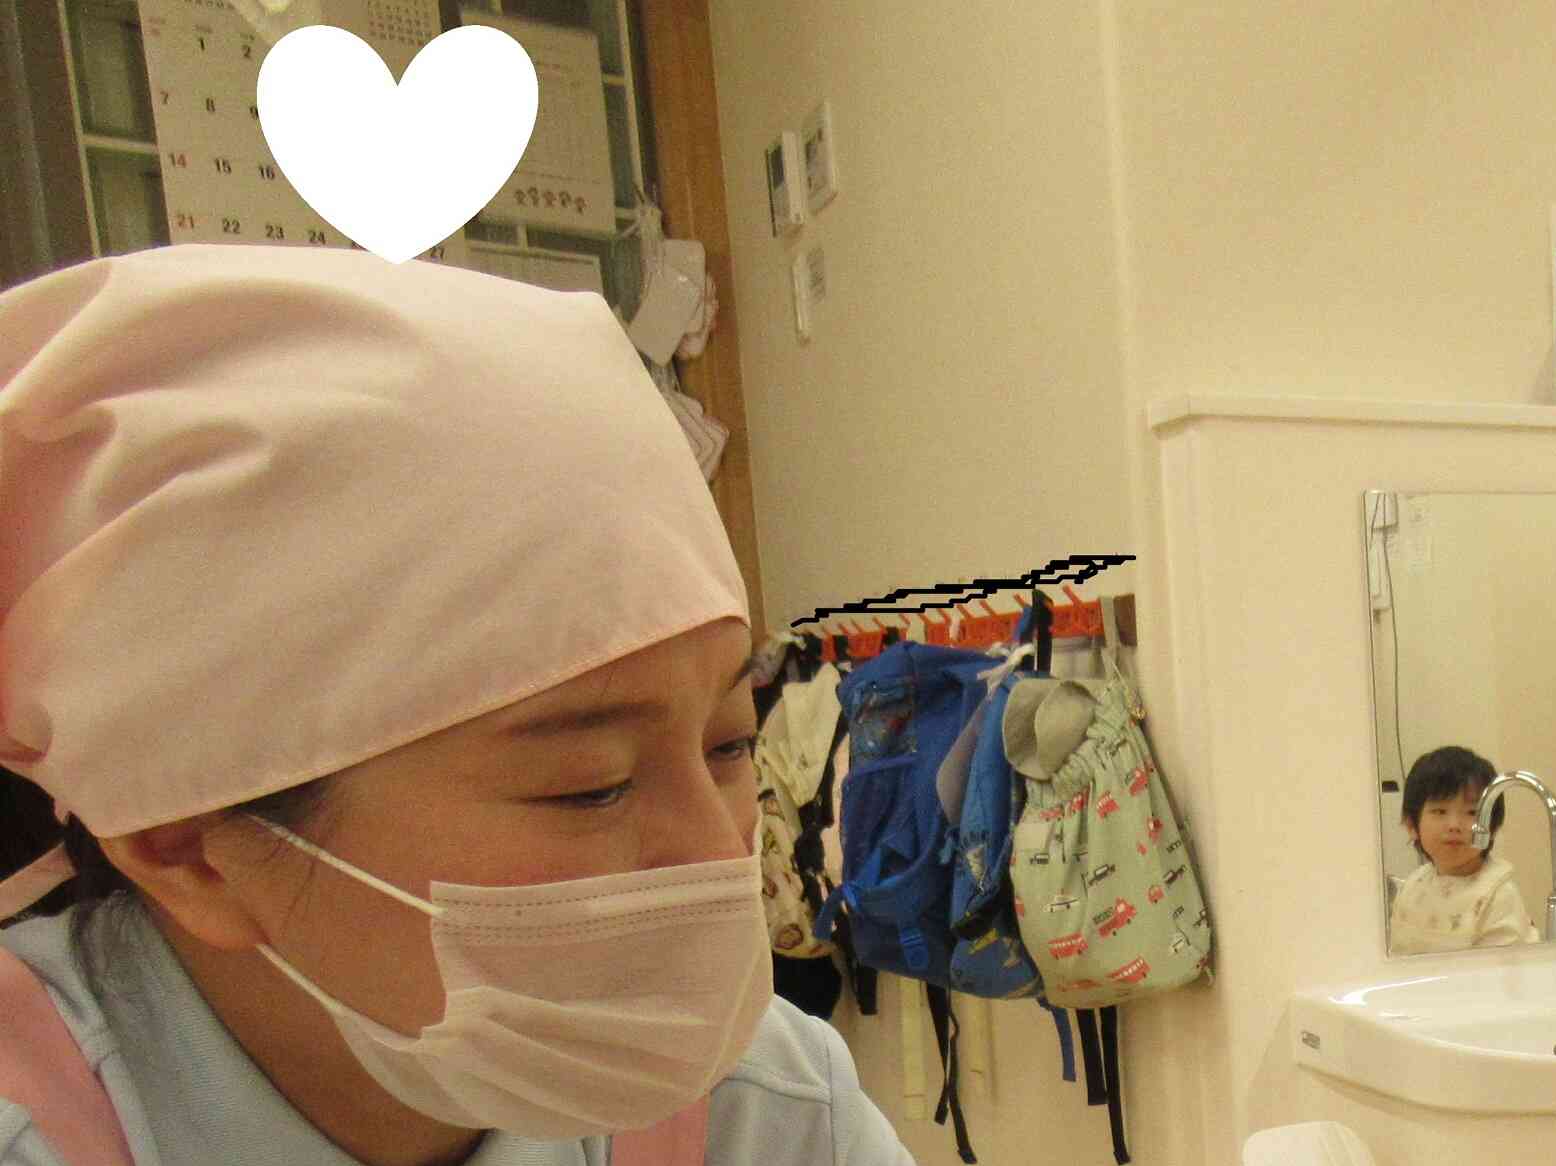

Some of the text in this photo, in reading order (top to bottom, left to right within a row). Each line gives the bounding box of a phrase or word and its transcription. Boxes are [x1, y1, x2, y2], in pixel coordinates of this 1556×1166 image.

[168, 152, 276, 181] 14 15 16
[175, 213, 195, 230] 21
[221, 217, 241, 235] 22
[265, 223, 285, 240] 23
[307, 229, 327, 246] 24
